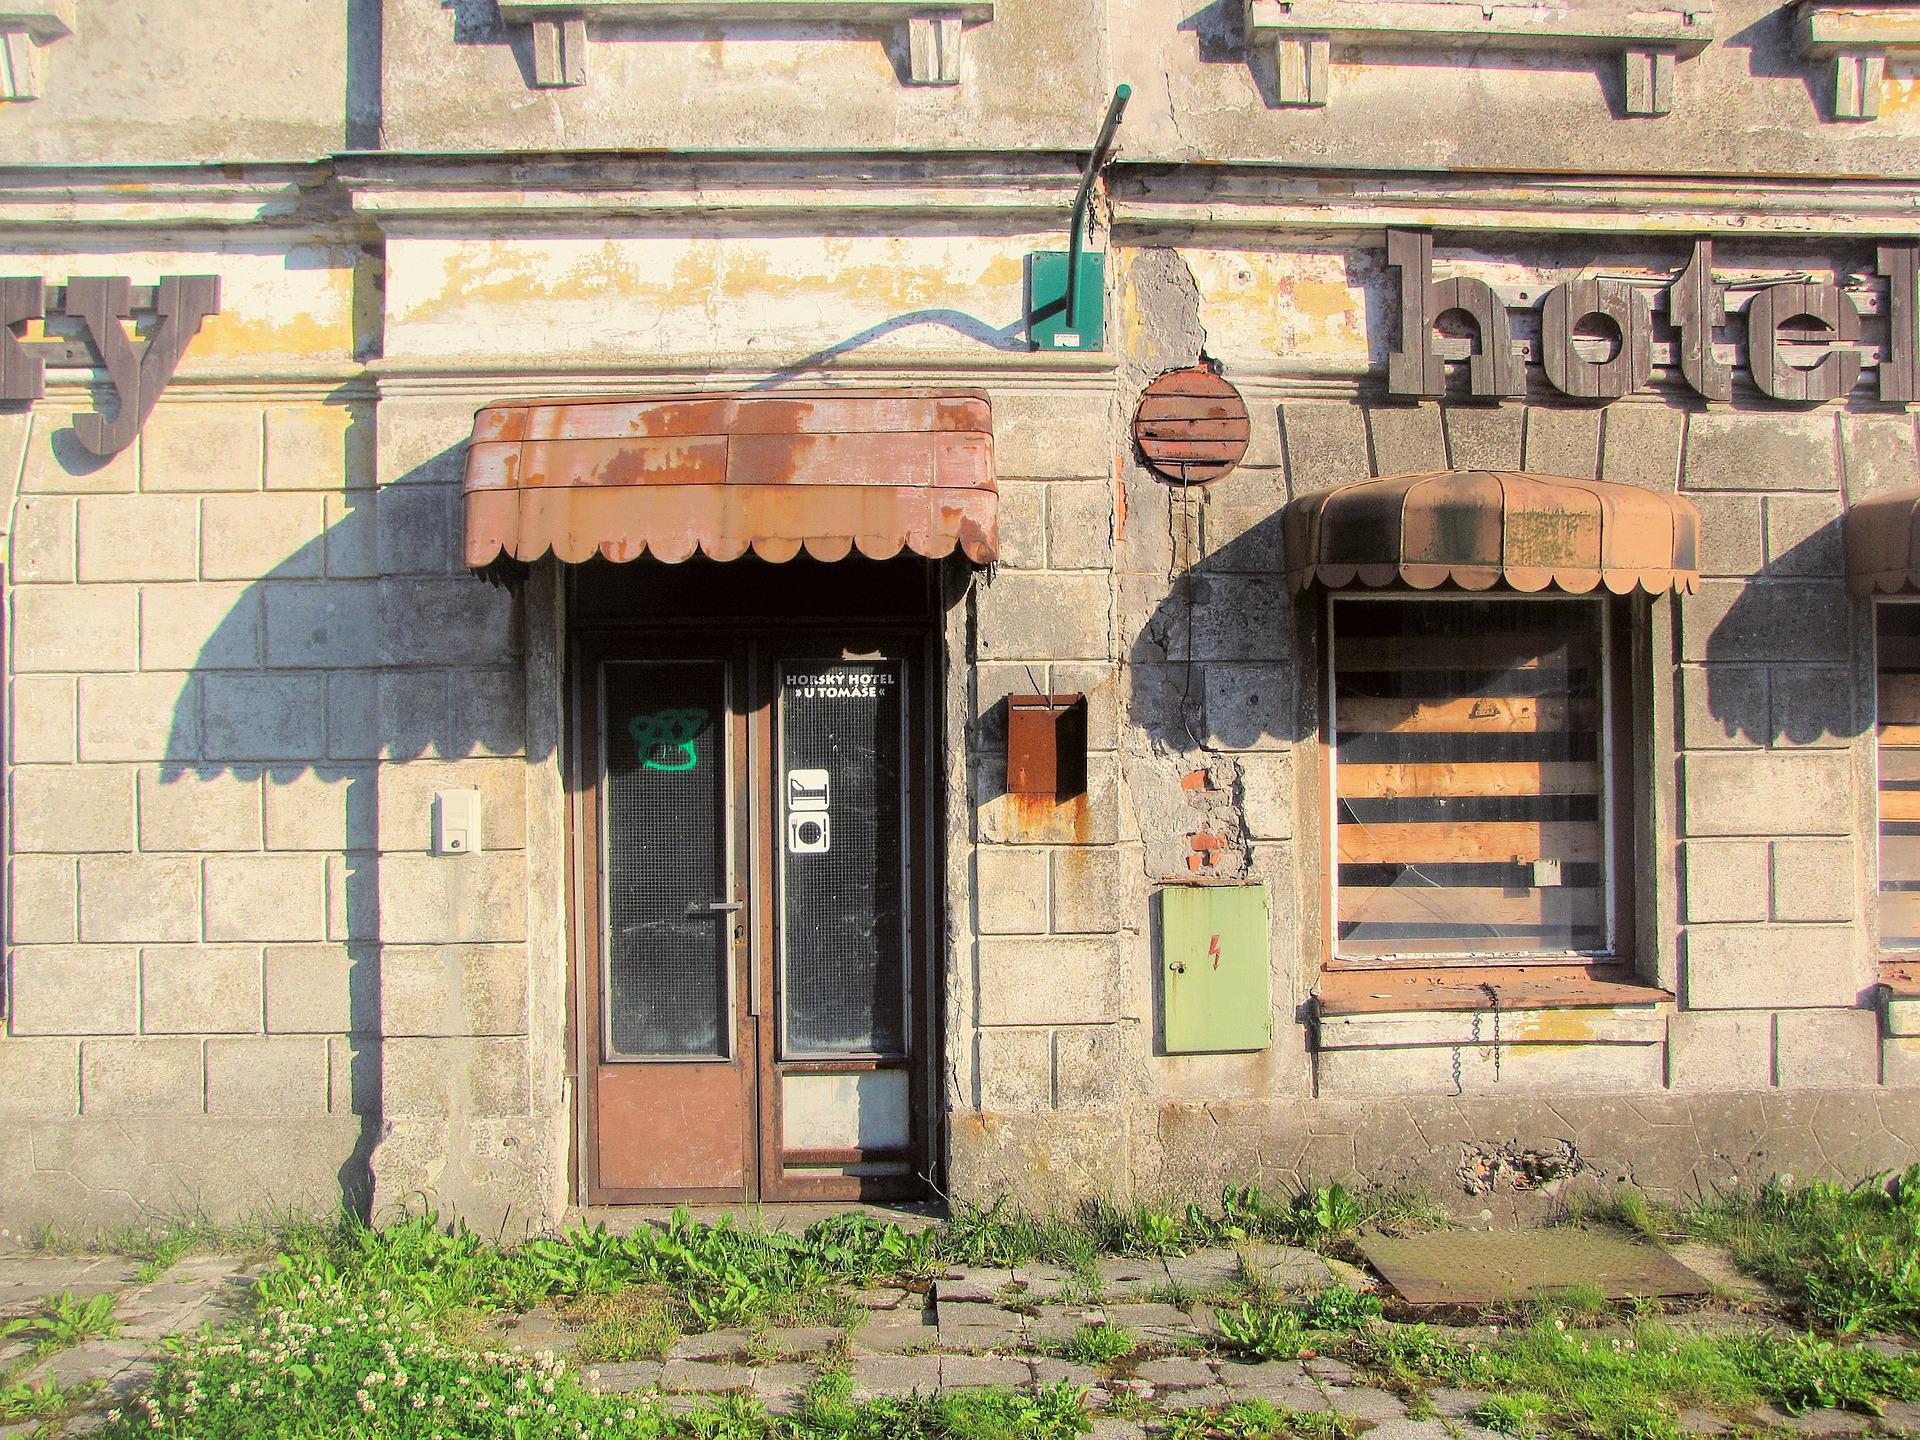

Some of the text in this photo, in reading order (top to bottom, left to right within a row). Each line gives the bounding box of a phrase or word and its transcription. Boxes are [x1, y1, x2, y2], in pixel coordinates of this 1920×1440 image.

[1387, 227, 1920, 401] hotel
[786, 672, 895, 685] HORSKÝ HOTEL
[817, 684, 877, 698] TOMÁŠE
